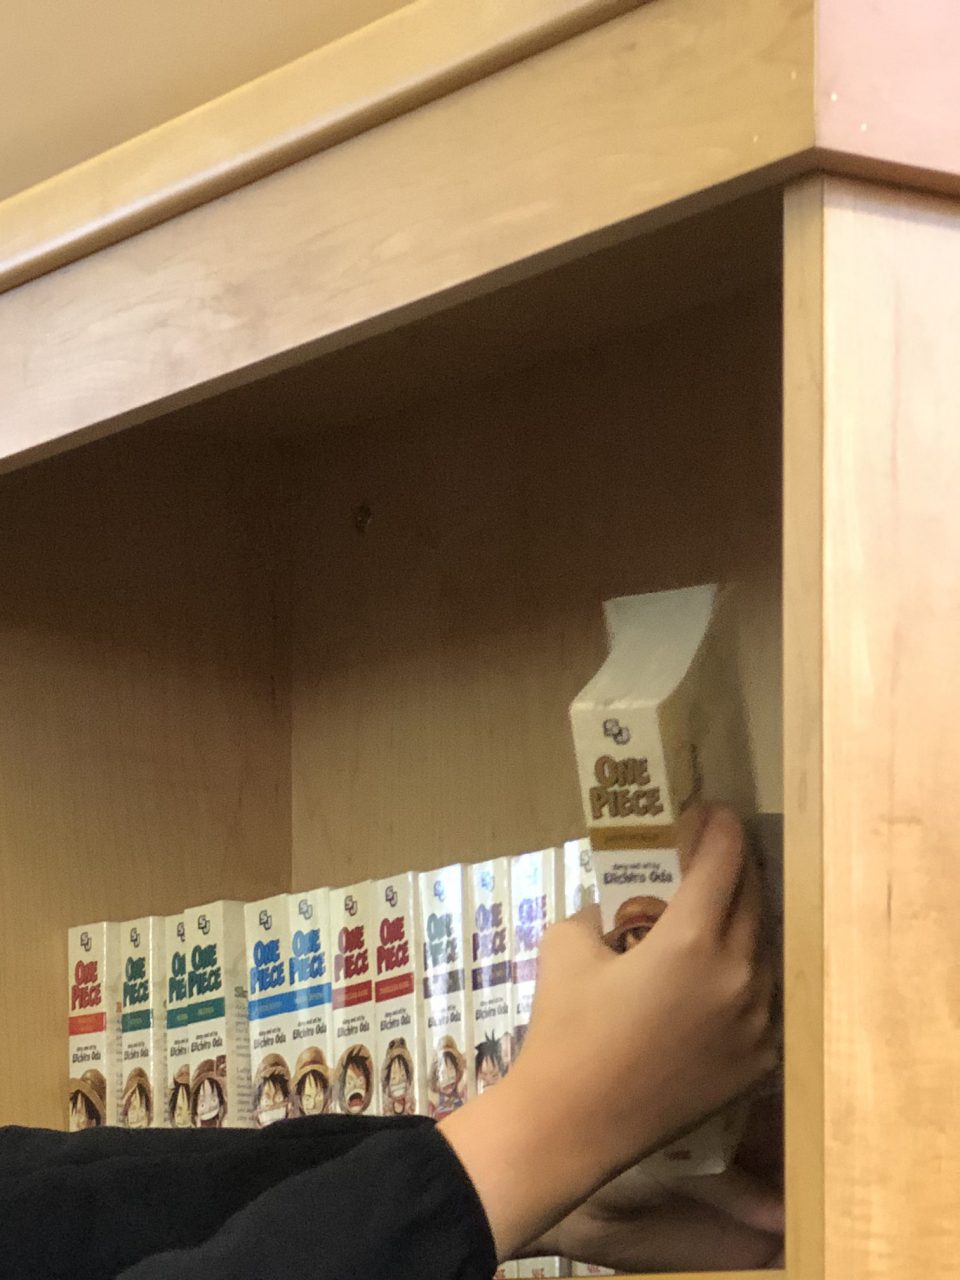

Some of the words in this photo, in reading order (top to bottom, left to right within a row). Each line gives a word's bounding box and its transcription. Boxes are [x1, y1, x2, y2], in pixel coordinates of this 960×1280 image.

[594, 754, 651, 787] ONE
[589, 786, 664, 820] PIECE
[292, 928, 321, 957] ONE
[338, 925, 365, 954] ONE
[379, 916, 405, 946] ONE
[171, 951, 187, 978] ON
[191, 943, 217, 972] ONE
[253, 938, 281, 967] ONE
[334, 949, 369, 983] PIECE
[376, 941, 410, 975] PIECE
[74, 960, 98, 985] ONE
[125, 956, 146, 982] ONE
[188, 966, 222, 999] PIECE
[250, 962, 286, 995] PIECE
[289, 952, 326, 985] PIECE
[71, 983, 102, 1011] PIECE
[123, 980, 149, 1008] PIECE
[169, 976, 188, 1004] PIE
